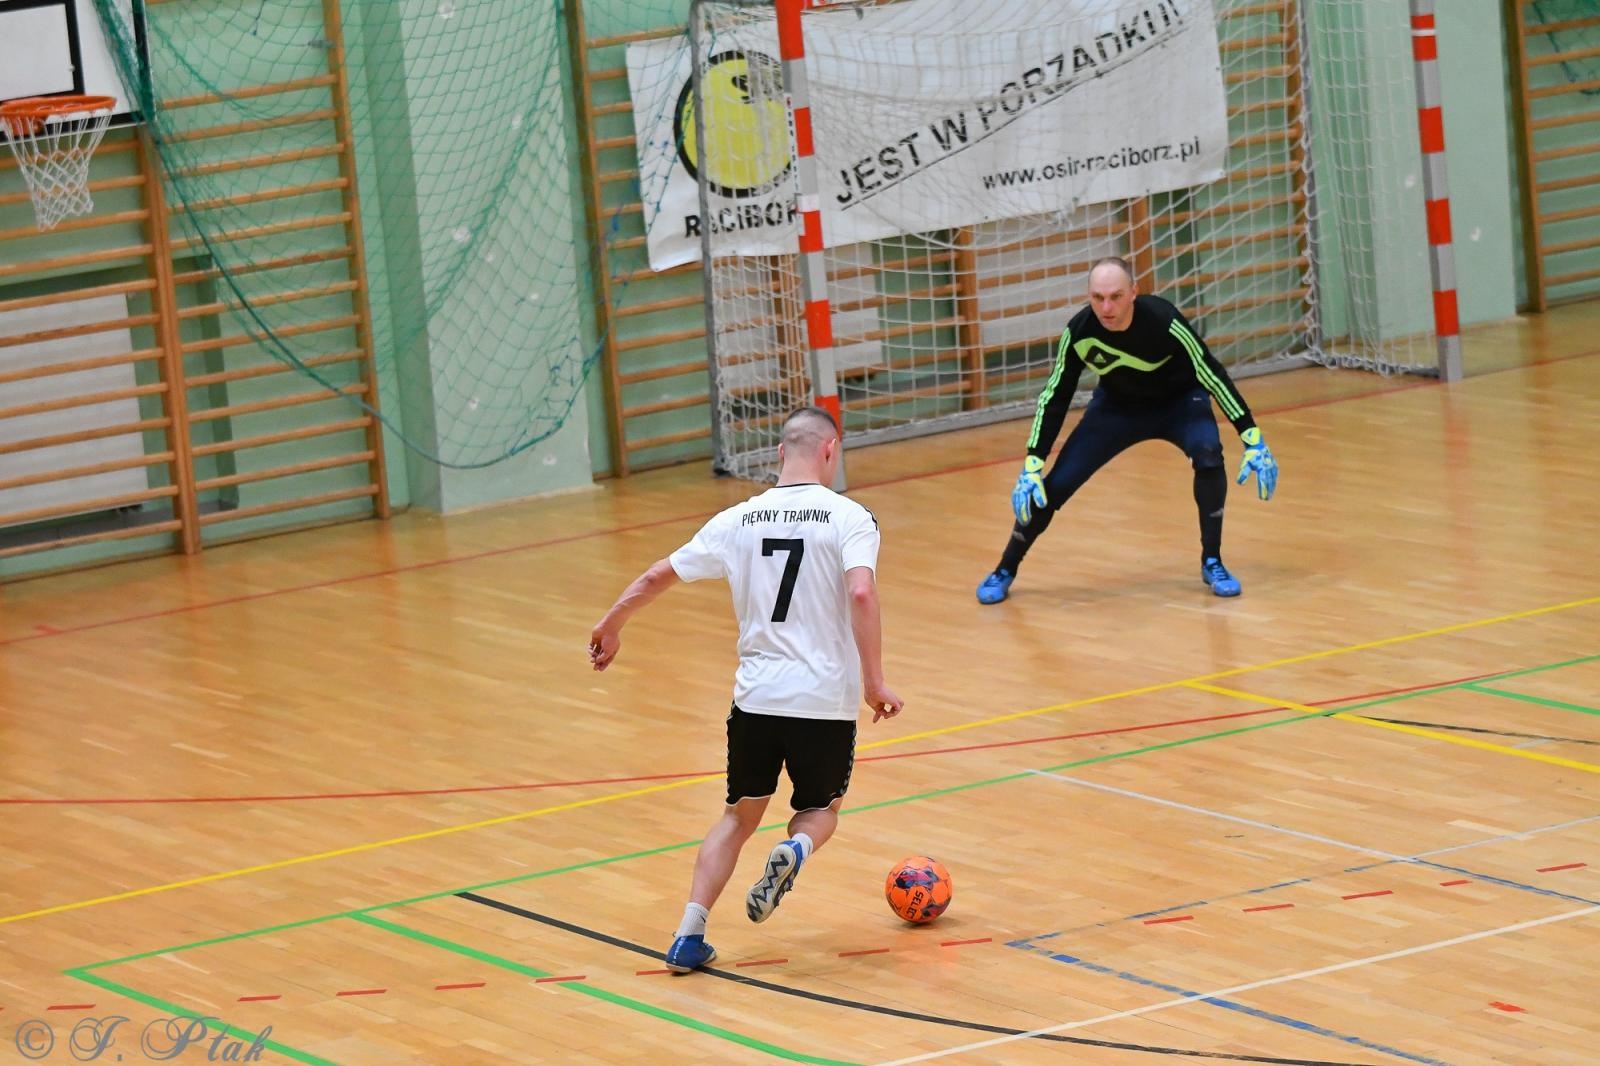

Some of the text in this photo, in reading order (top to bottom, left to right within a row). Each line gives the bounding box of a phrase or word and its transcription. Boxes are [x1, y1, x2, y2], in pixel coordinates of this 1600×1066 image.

[836, 132, 920, 204] JEST
[929, 112, 968, 151] W
[742, 508, 832, 527] PIĘKNY TRAWNIK
[761, 537, 805, 623] 7
